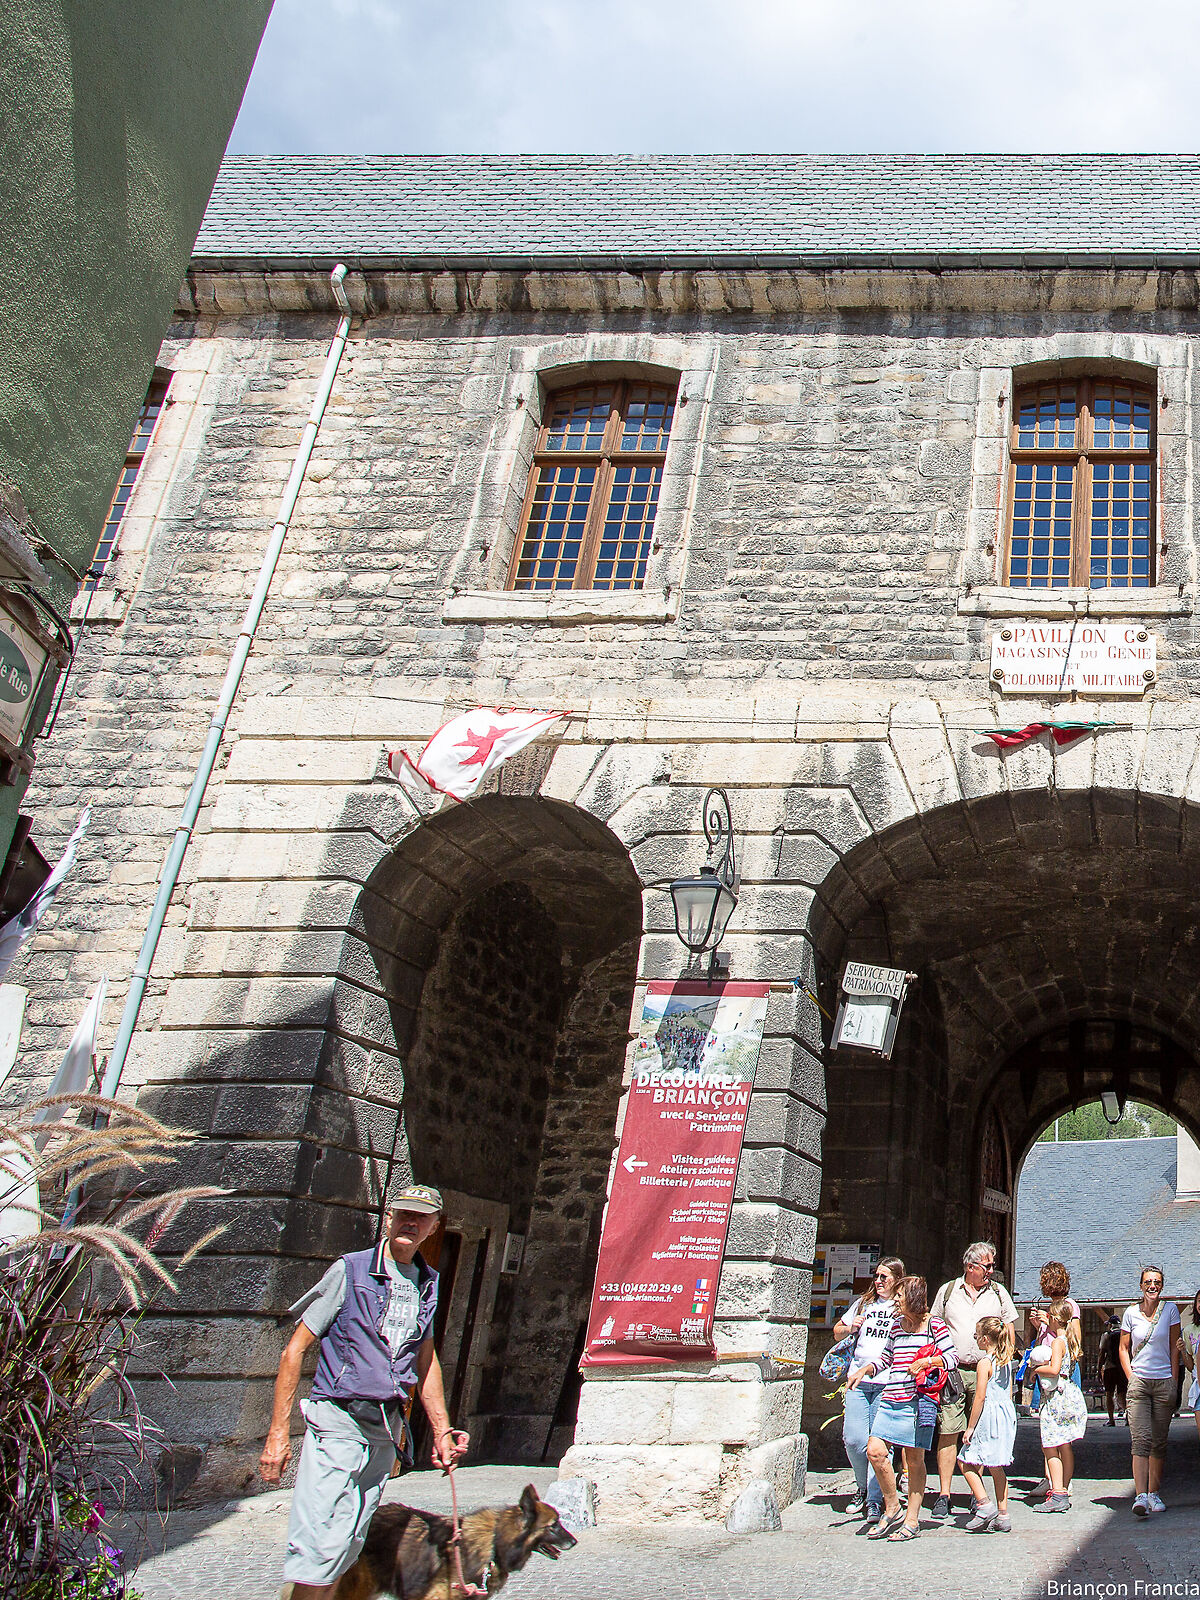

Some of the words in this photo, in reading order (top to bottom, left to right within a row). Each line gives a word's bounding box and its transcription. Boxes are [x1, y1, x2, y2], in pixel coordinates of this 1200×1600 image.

[1013, 628, 1106, 644] PAVILLON
[996, 647, 1070, 659] MAGASINS
[0, 656, 8, 678] e
[8, 666, 29, 697] Rue
[1002, 673, 1075, 687] COLOMBIER
[1082, 673, 1144, 687] MILITAIRE
[847, 963, 885, 980] SERVICE
[887, 970, 904, 983] DU
[843, 976, 900, 997] PATRIMOINE
[652, 1088, 749, 1110] BRIANÇON
[659, 1111, 684, 1120] avec
[684, 1109, 695, 1120] le
[731, 1111, 744, 1121] du
[689, 1122, 743, 1133] Patrimoine
[671, 1154, 704, 1165] Visites
[704, 1154, 737, 1166] guidées
[659, 1164, 698, 1175] Ateliers
[697, 1165, 735, 1175] scolaires
[639, 1176, 689, 1187] Billetterie
[694, 1177, 732, 1188] Boutique
[687, 1252, 719, 1261] Boutique
[600, 1283, 620, 1293] +33
[866, 1310, 896, 1320] ATELI
[865, 1326, 890, 1339] PARI
